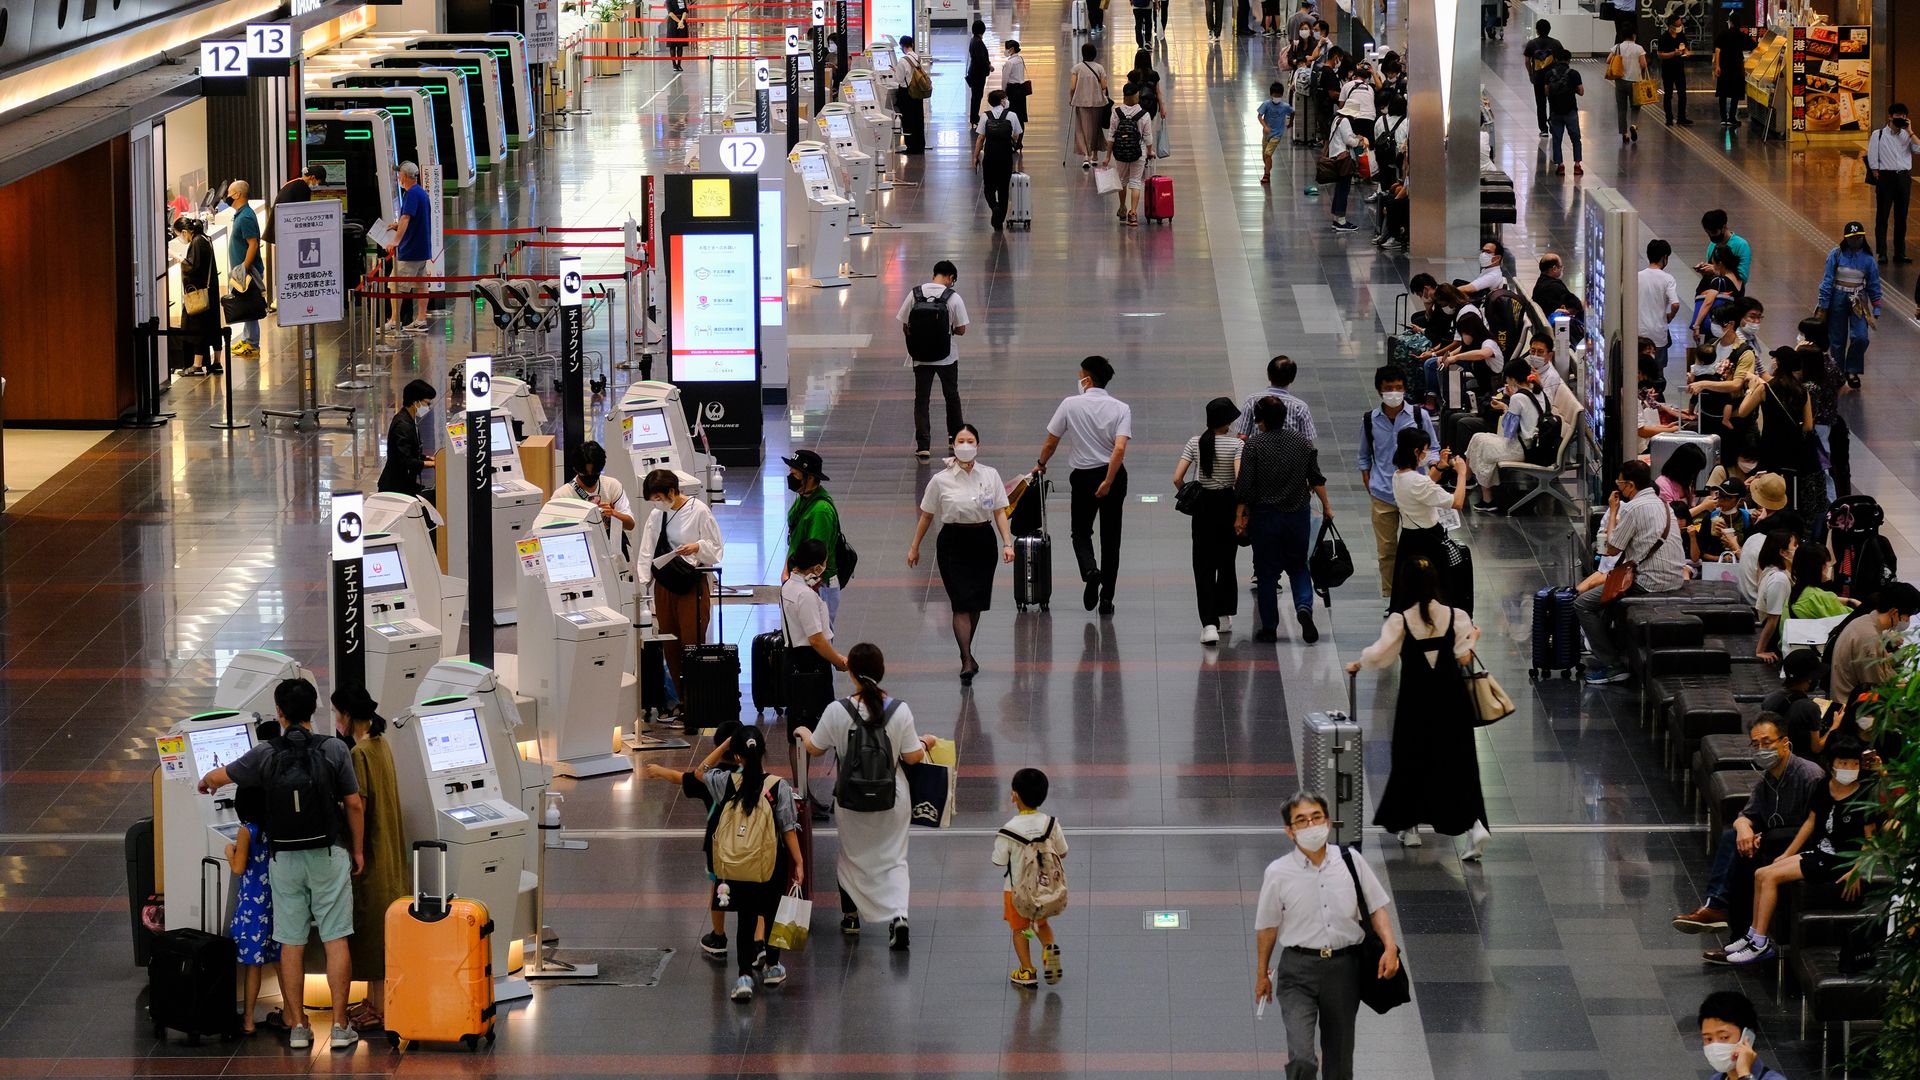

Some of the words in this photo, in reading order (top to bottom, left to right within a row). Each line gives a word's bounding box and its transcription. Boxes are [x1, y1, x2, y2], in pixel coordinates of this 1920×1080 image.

[253, 29, 284, 53] 13
[208, 46, 241, 71] 12
[760, 91, 768, 133] チェックイン
[728, 142, 758, 167] 12
[648, 182, 654, 204] 入口
[284, 279, 336, 290] ご利用のお客さまは
[287, 270, 333, 281] 保安検査場のみを
[568, 309, 579, 373] チェックイン
[475, 415, 487, 490] チェックイン
[343, 564, 359, 654] チェックイン
